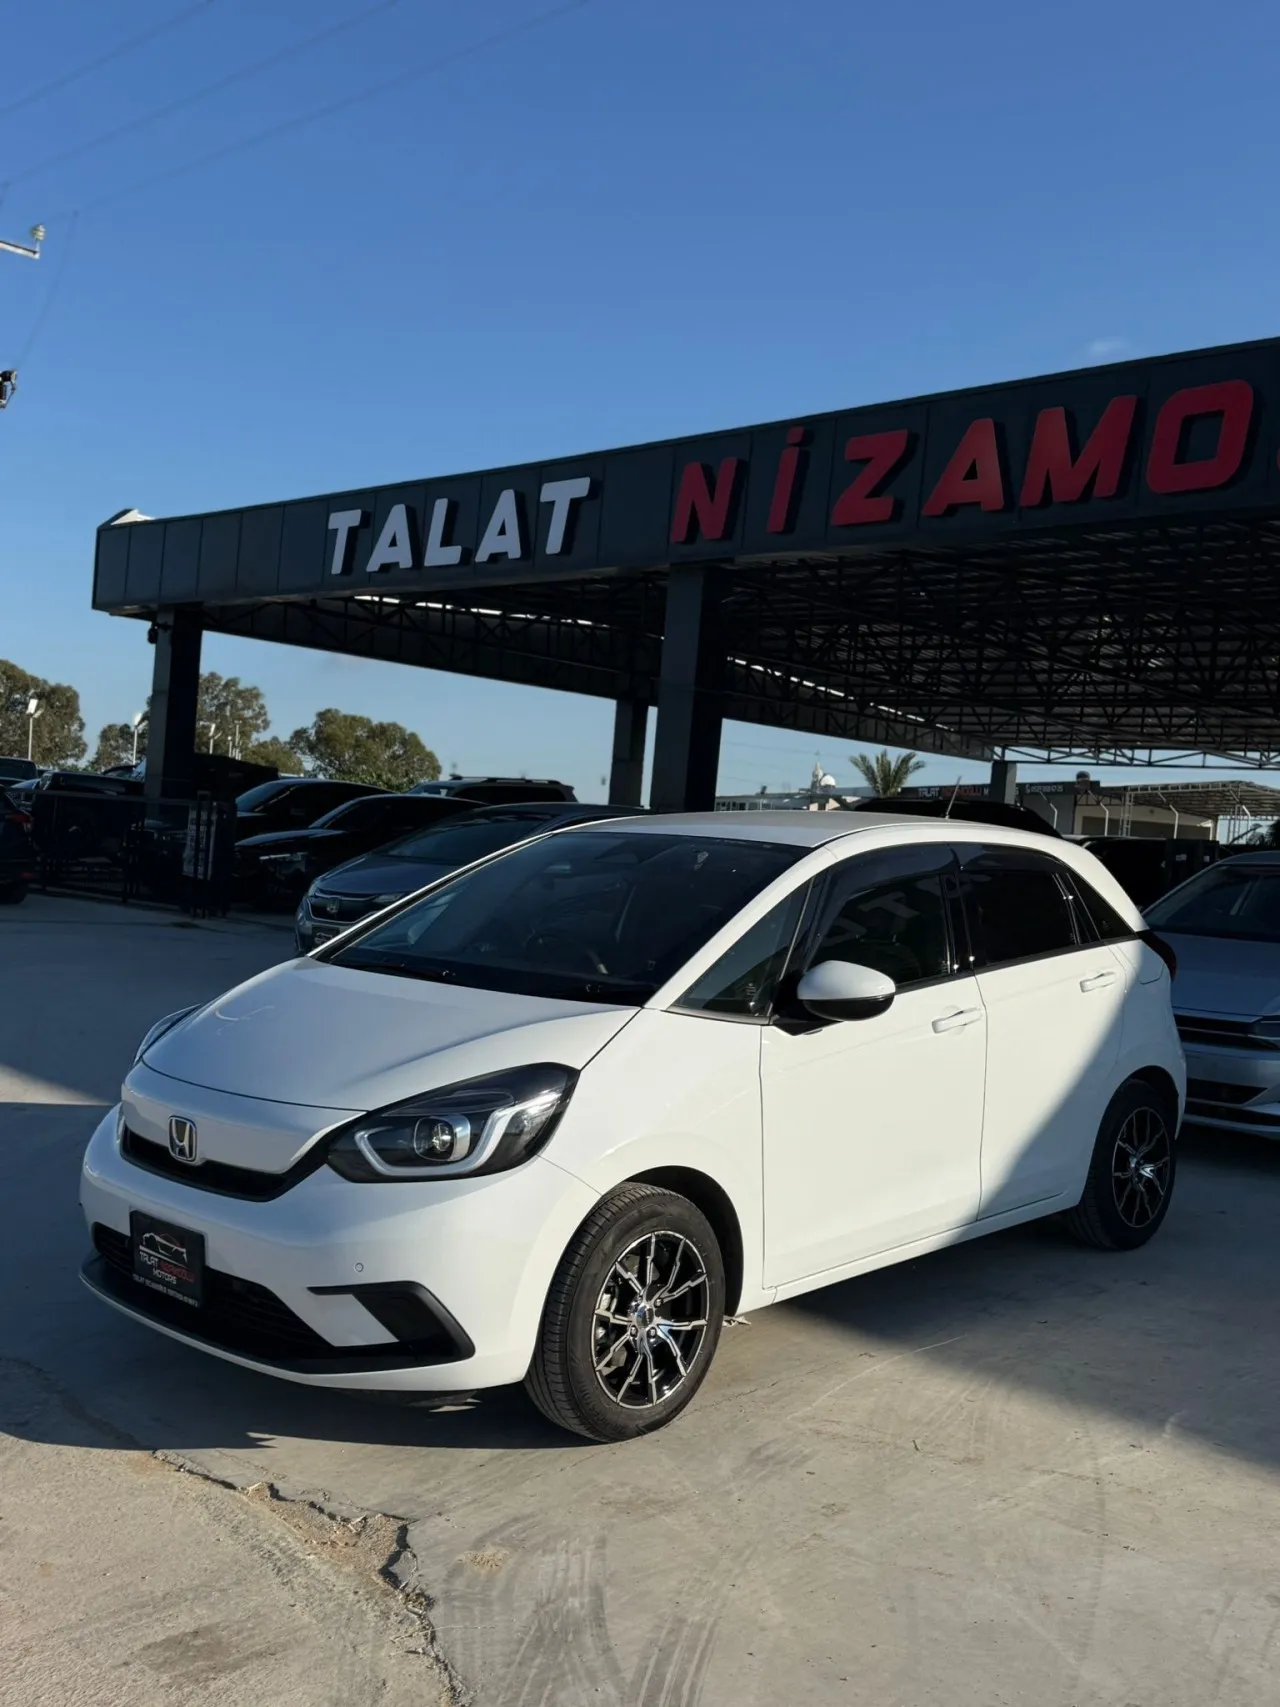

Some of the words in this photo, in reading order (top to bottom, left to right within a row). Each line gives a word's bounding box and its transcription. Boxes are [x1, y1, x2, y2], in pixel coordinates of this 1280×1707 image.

[328, 477, 591, 575] TALAT
[671, 378, 1280, 544] NİZAMO
[152, 1267, 177, 1285] MOTORS
